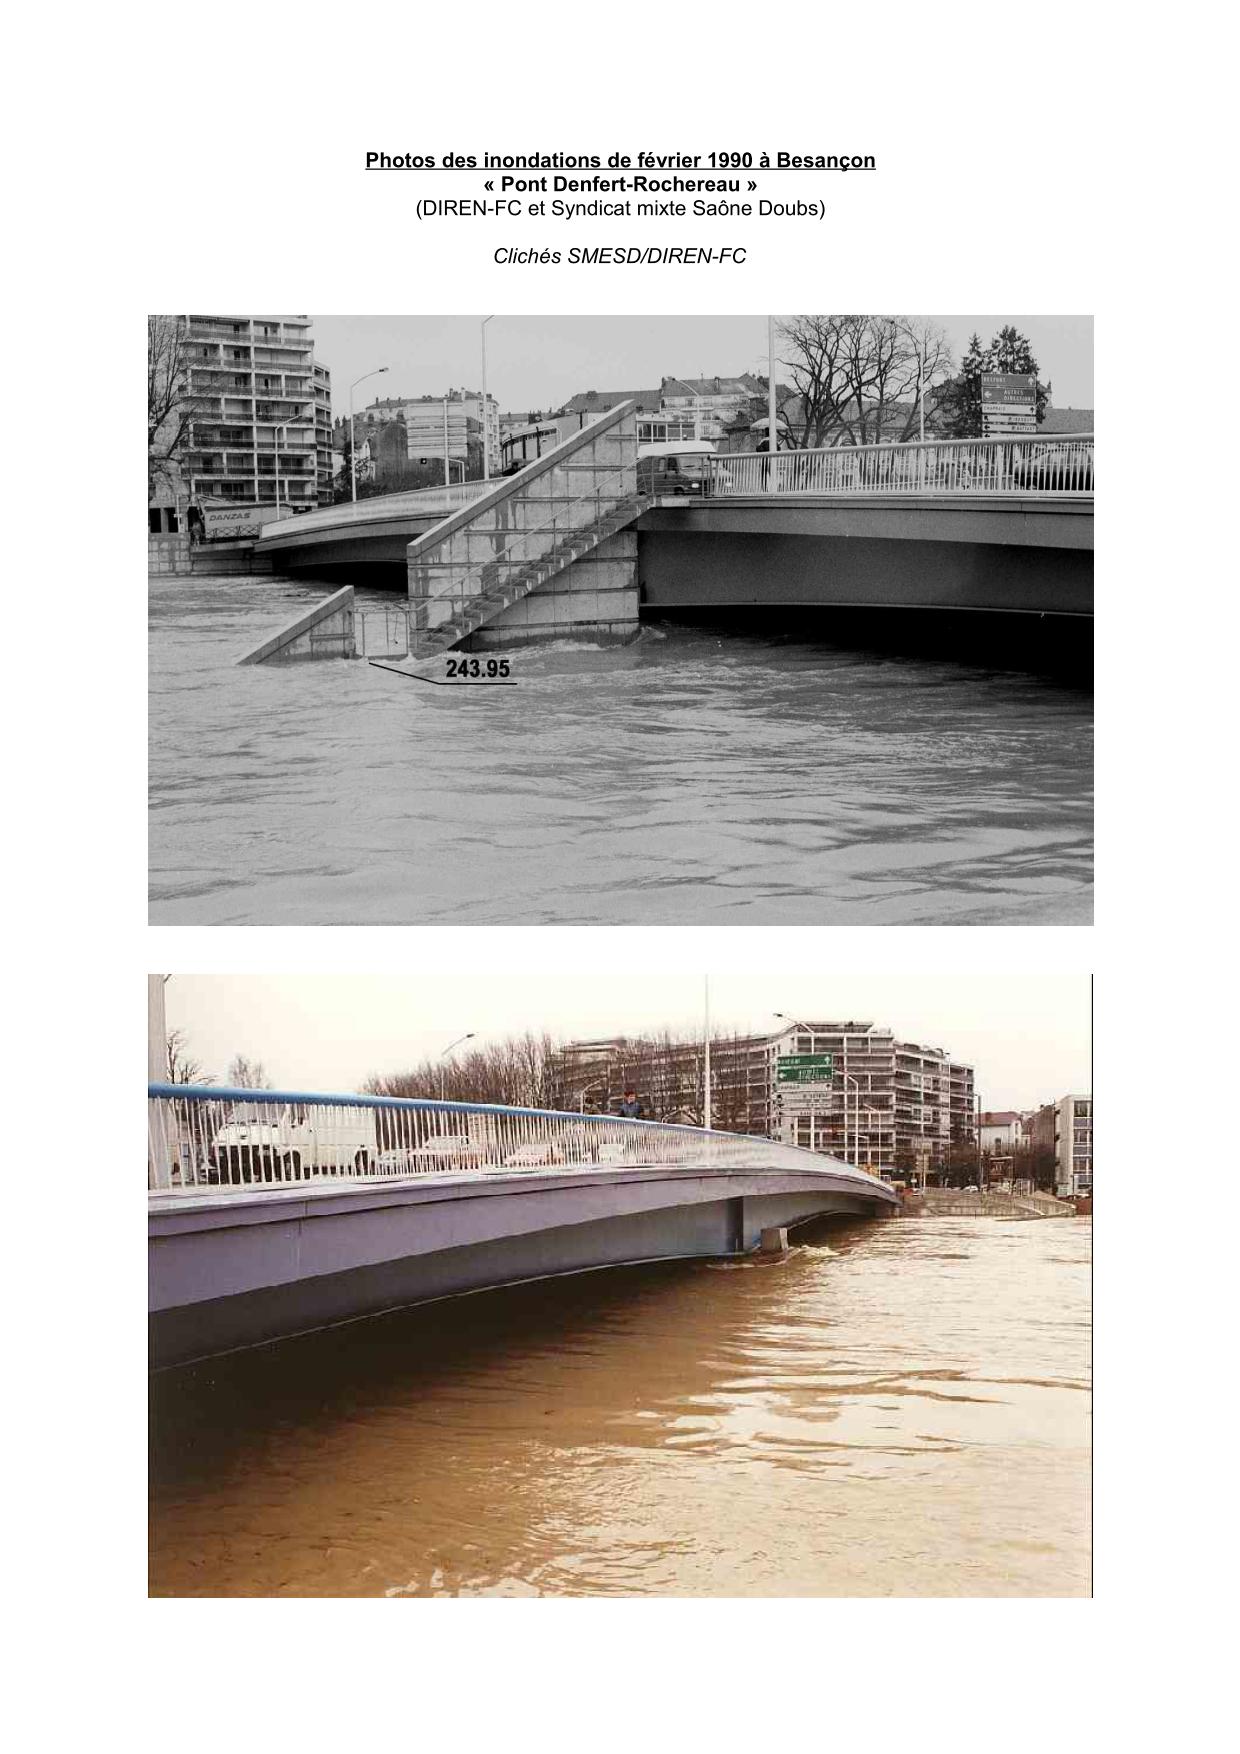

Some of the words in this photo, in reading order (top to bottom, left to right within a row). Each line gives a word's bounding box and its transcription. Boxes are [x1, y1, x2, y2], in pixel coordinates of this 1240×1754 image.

[366, 151, 436, 169] Photos
[442, 151, 478, 169] des
[484, 151, 601, 169] inondations
[607, 151, 632, 169] de
[637, 151, 702, 169] février
[707, 151, 753, 169] 1990
[759, 151, 771, 169] à
[777, 151, 876, 172] Besançon
[501, 175, 548, 193] Pont
[553, 175, 740, 193] Denfert-Rochereau
[416, 199, 522, 220] (DIREN-FC
[528, 200, 546, 217] et
[551, 199, 632, 221] Syndicat
[637, 199, 687, 216] mixte
[692, 199, 753, 217] Saône
[759, 199, 826, 221] Doubs)
[493, 247, 562, 264] Clichés
[567, 247, 747, 264] SMESD/DIREN-FC
[209, 512, 252, 522] DANZAS
